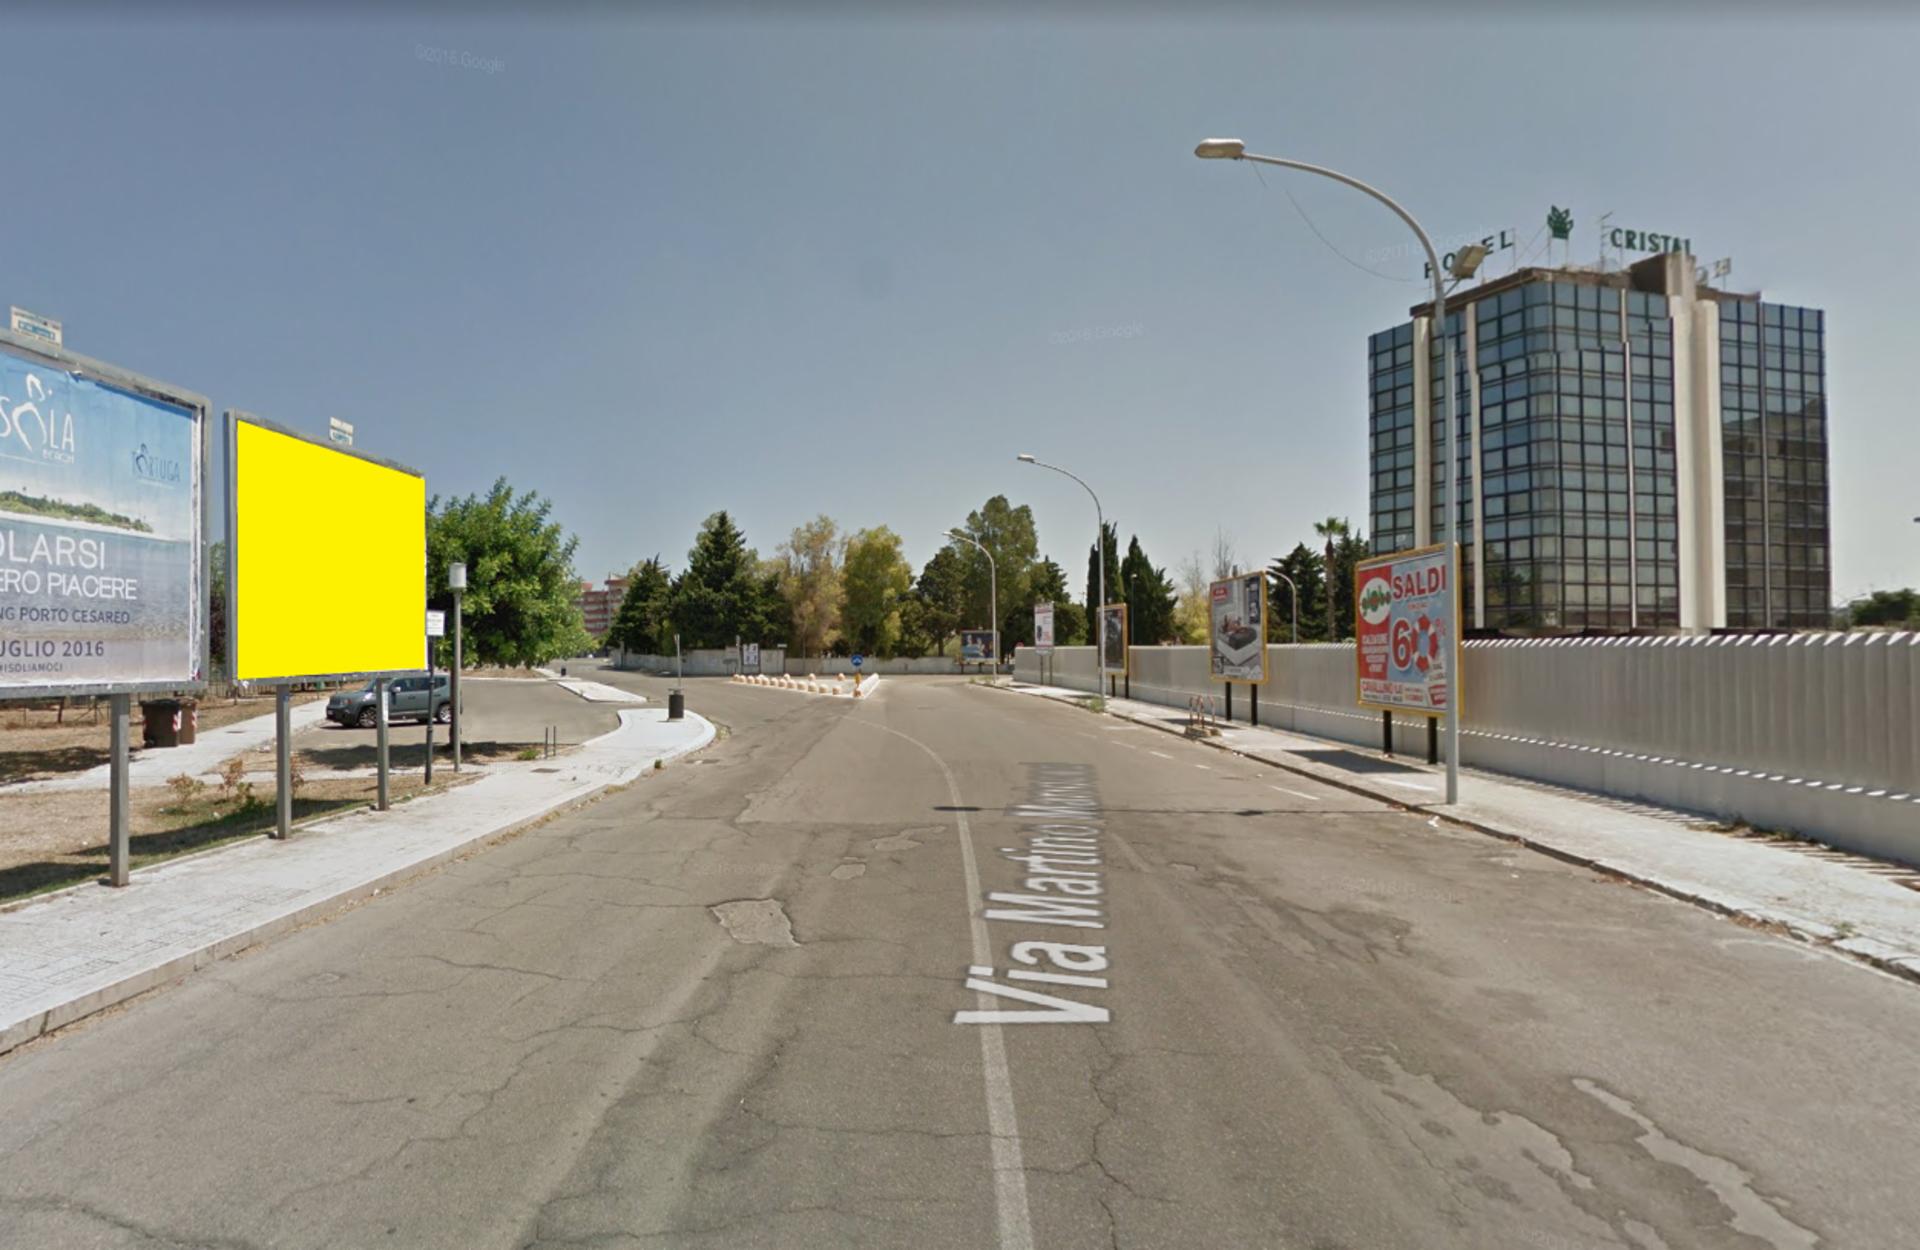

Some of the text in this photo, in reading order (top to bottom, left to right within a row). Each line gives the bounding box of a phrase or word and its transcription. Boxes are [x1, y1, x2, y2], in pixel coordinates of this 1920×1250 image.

[0, 530, 105, 570] LARSI
[47, 572, 138, 600] PIACERE
[1393, 565, 1447, 599] SALDI
[20, 606, 69, 622] PORTO
[72, 609, 130, 624] CESAREO
[62, 640, 104, 657] 2016
